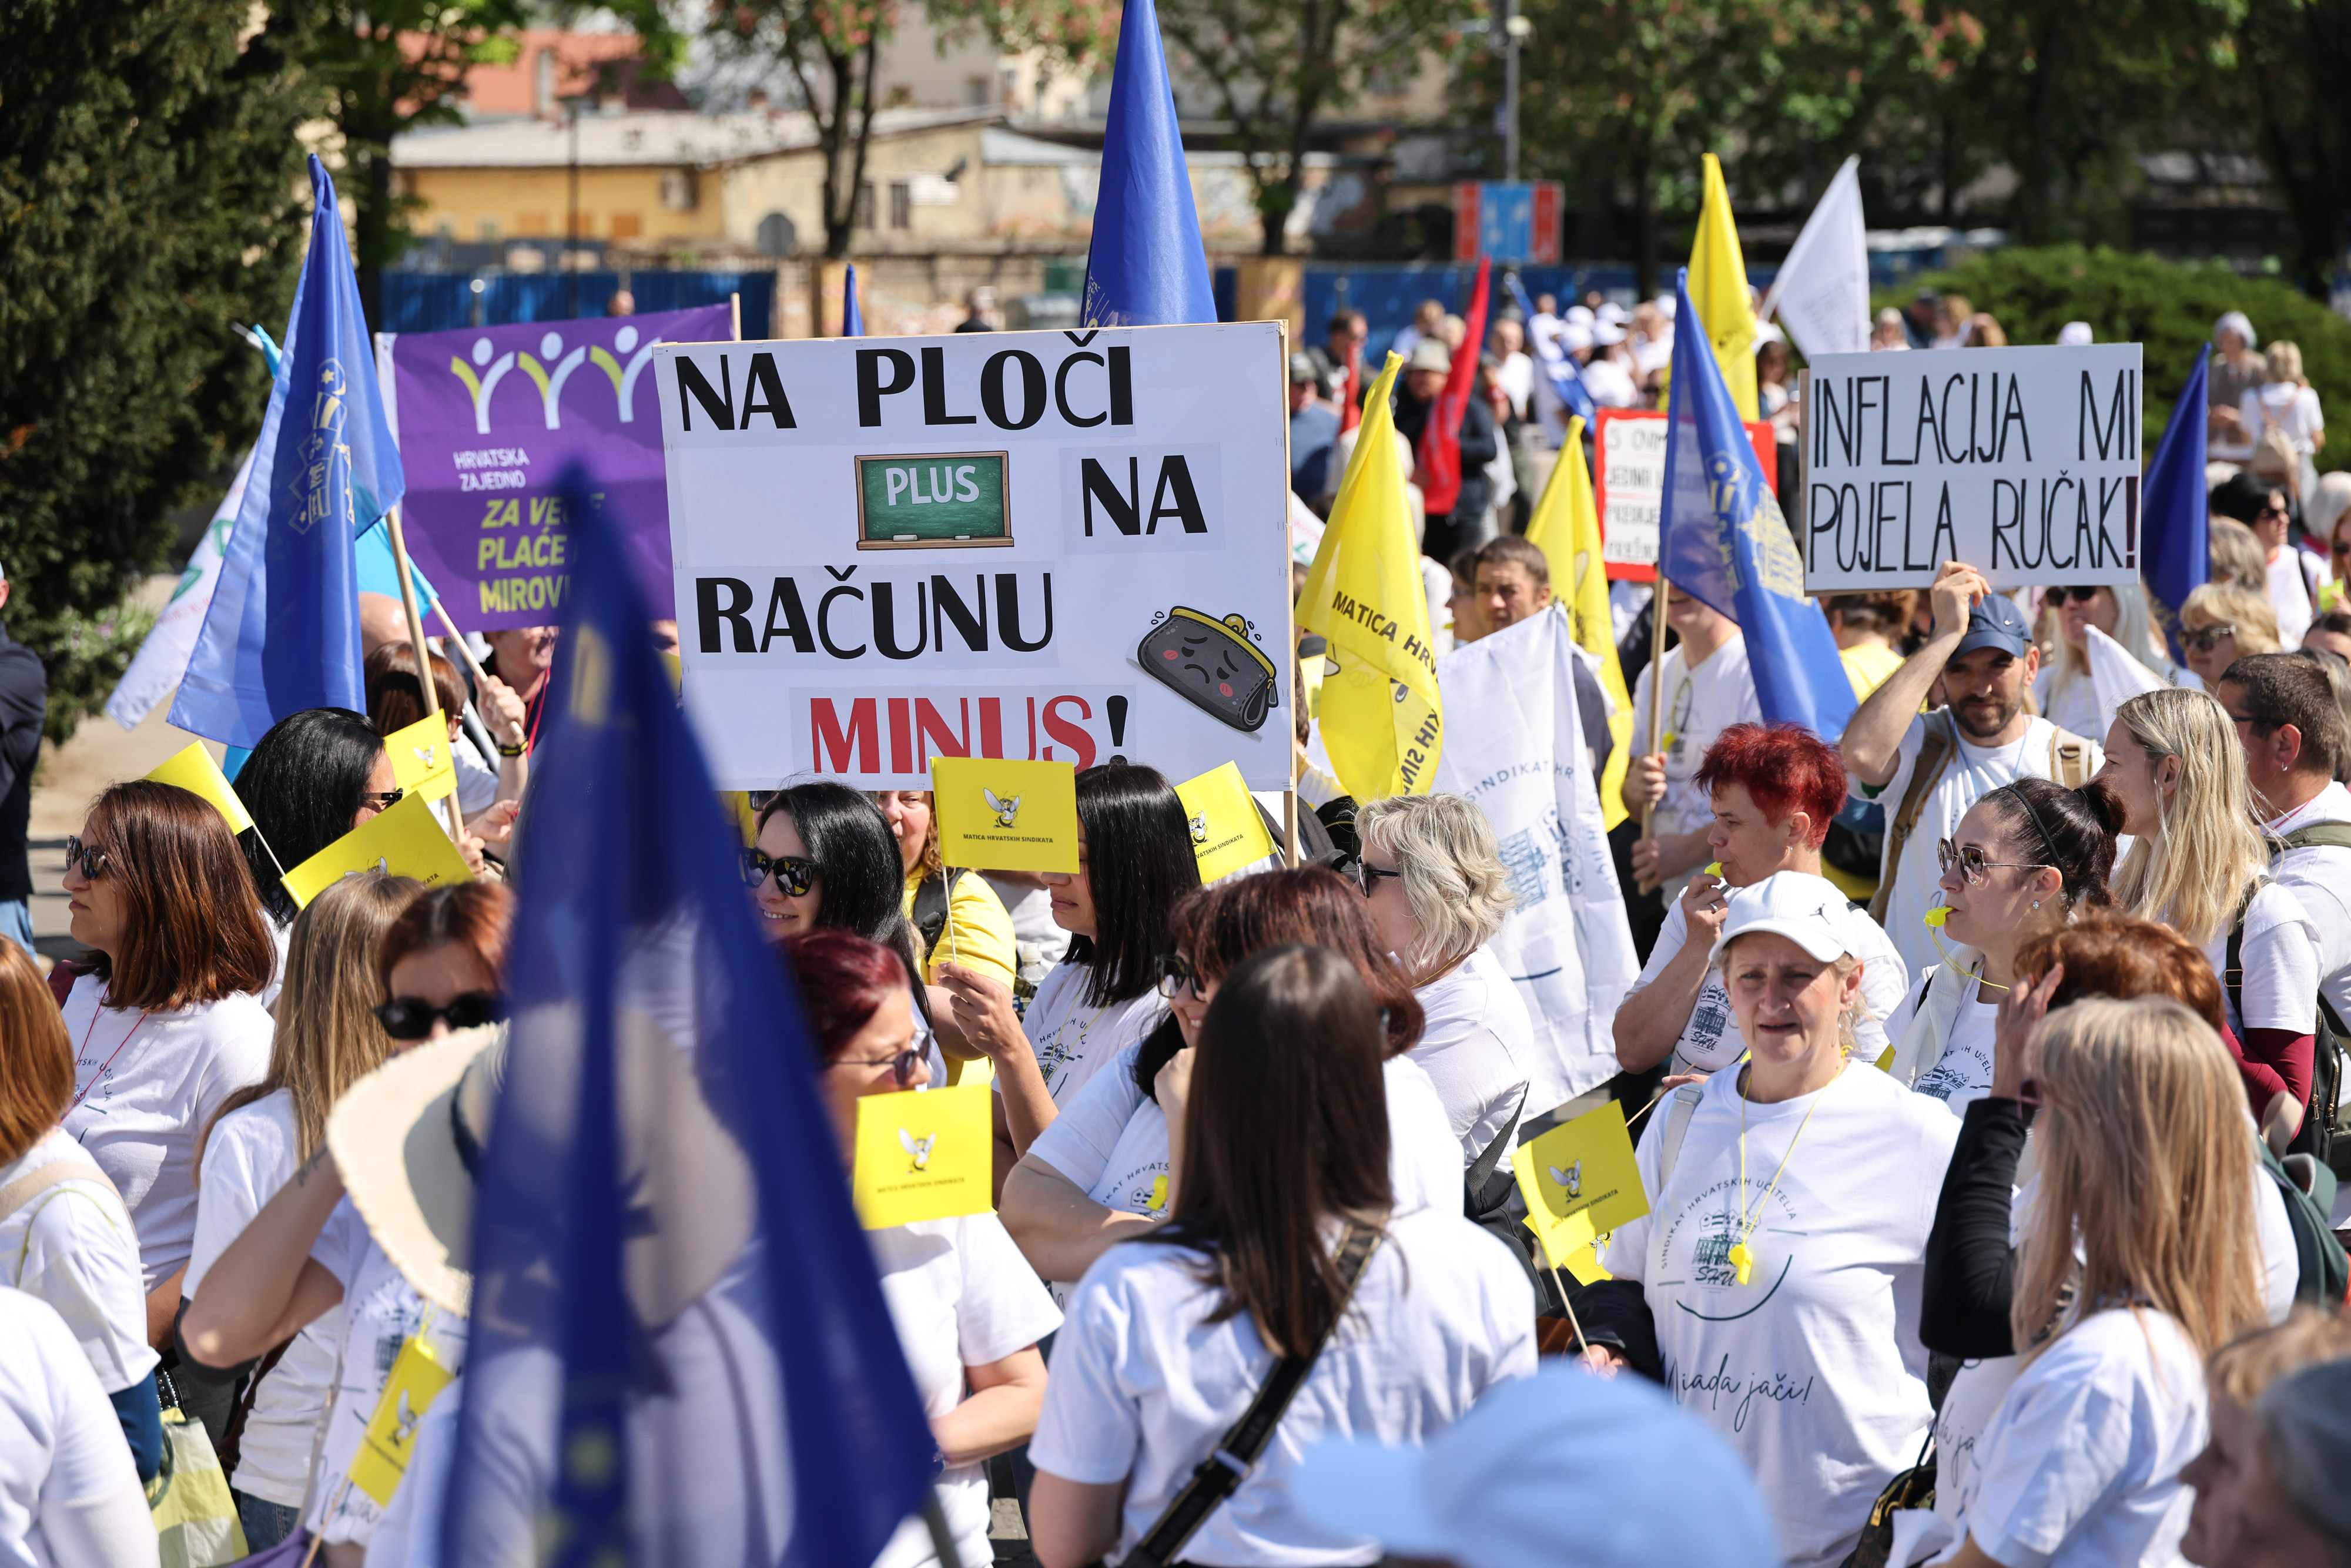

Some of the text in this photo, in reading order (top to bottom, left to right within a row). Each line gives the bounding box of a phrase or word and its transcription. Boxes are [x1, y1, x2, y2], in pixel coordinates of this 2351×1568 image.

[675, 330, 1133, 431] NA PLOČI
[1814, 369, 2135, 468] INFLACIJA MI
[453, 447, 531, 470] HRVATSKA
[458, 470, 527, 492] ZAJEDNO
[481, 498, 520, 529] ZA
[885, 455, 1208, 537] PLUS NA
[1810, 470, 2139, 573] POJELA RUČAK!
[477, 526, 568, 571] PLAĆE
[695, 565, 1053, 660] RAČUNU
[1332, 590, 1398, 642] MATICA
[810, 695, 1129, 775] MINUS!
[1195, 834, 1244, 859] VATSKIH SINDIKATA
[423, 873, 440, 884] KATA
[1690, 1031, 1717, 1051] SHU
[1127, 1162, 1169, 1180] HRVATS
[1590, 1188, 1619, 1207] SINDIKATA
[1661, 1177, 1797, 1270] SINDIKAT HRVATSKIH UČITELJA
[1695, 1265, 1736, 1287] SHU
[1734, 1373, 1814, 1432] jači!
